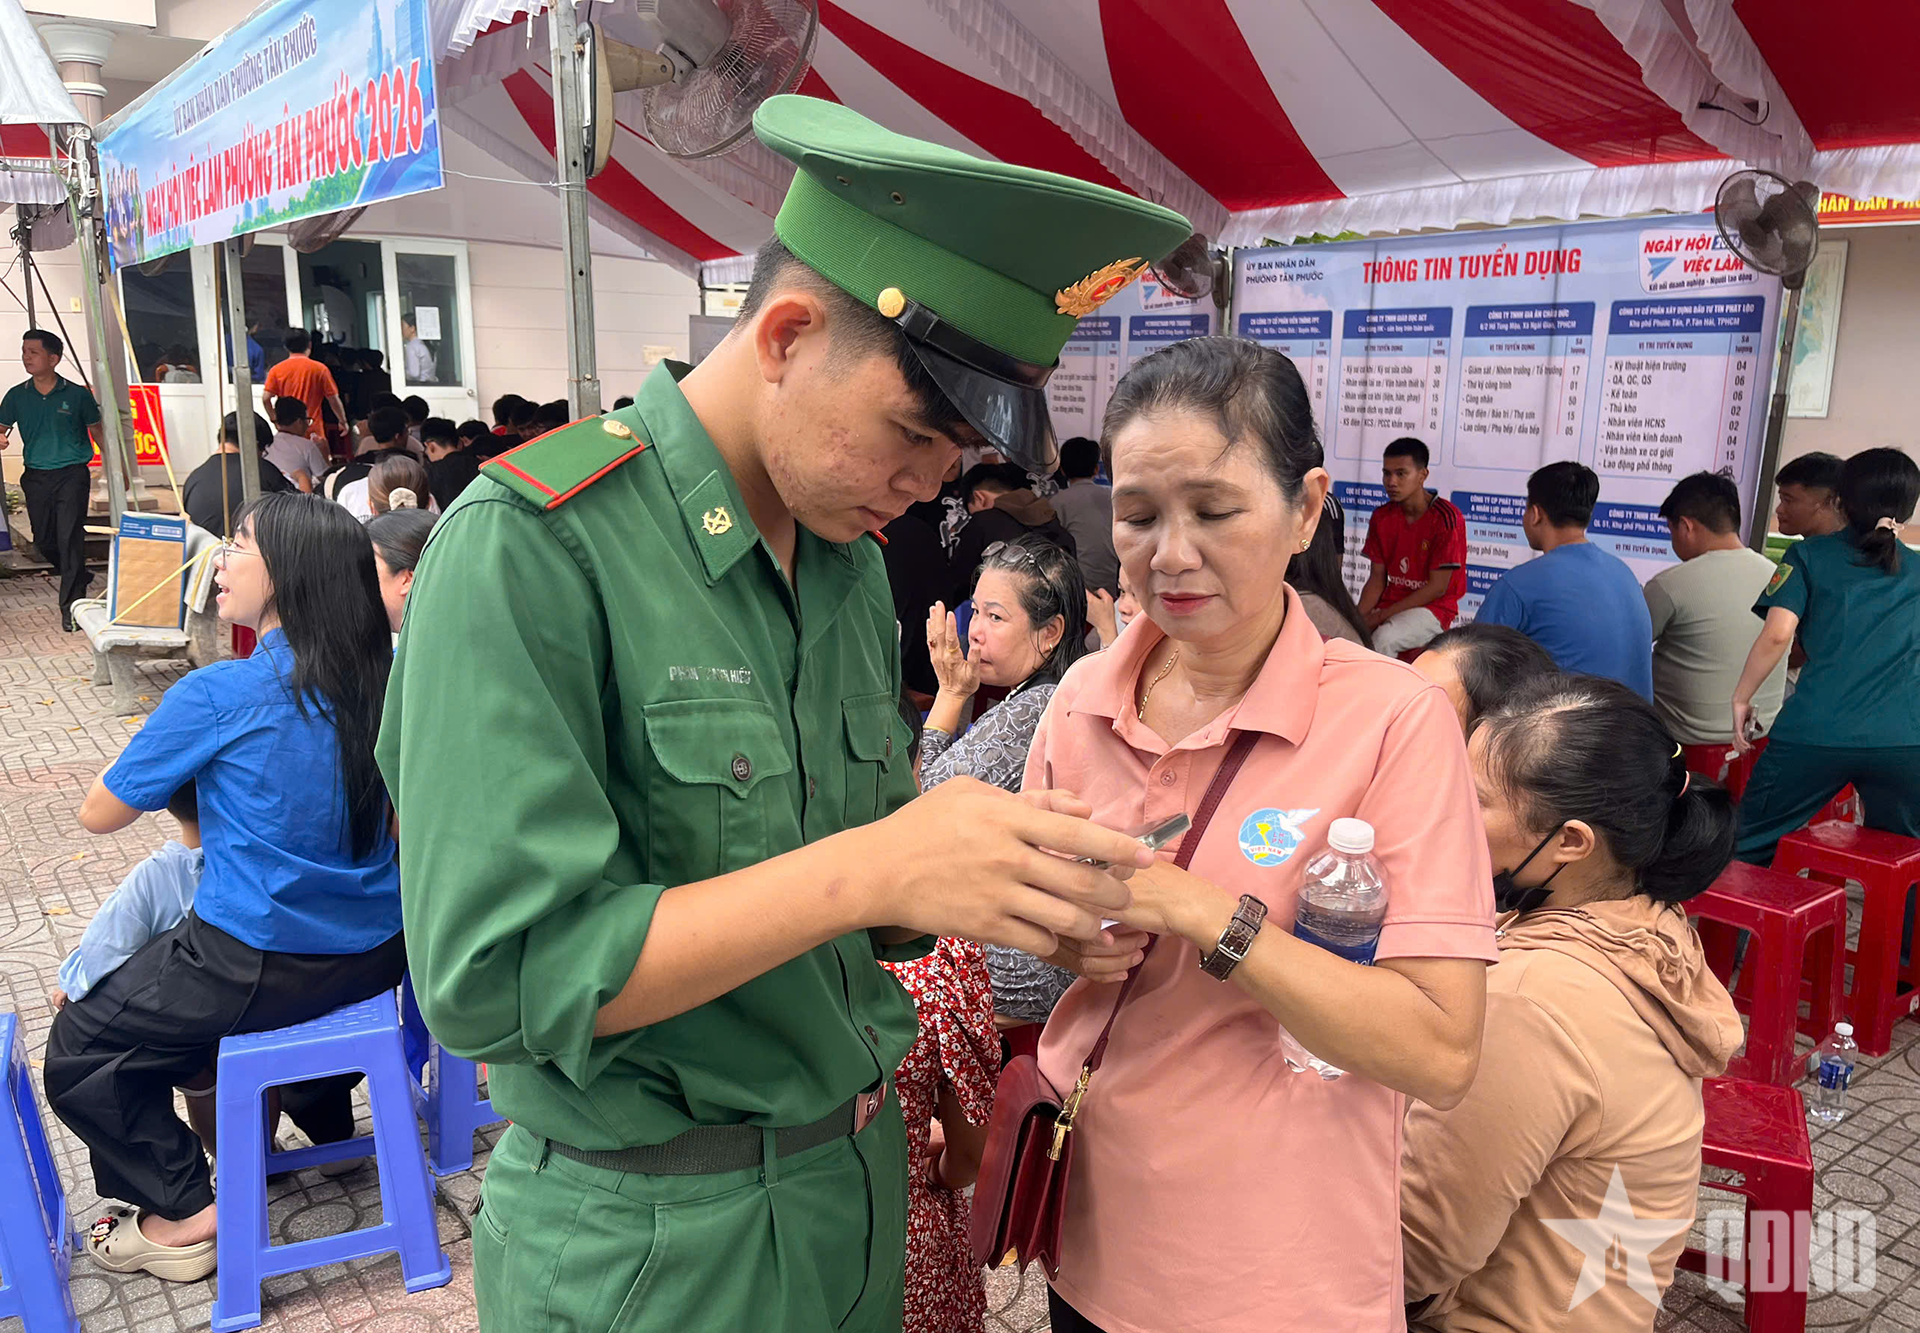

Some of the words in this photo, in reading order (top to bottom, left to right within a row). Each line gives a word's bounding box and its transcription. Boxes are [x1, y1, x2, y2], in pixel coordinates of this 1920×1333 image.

[215, 71, 231, 111] DÂN
[230, 52, 264, 101] PHƯỜNG
[264, 37, 283, 81] TÂN
[283, 14, 317, 70] PHƯỚC
[145, 171, 166, 238] NGÀY
[167, 161, 182, 242] HỘI
[182, 151, 202, 238] VIỆC
[202, 142, 223, 216] LÀM
[224, 119, 273, 209] PHƯỜNG
[275, 101, 302, 190] TÂN
[305, 69, 362, 181] PHƯỚC
[366, 60, 423, 163] 2026
[1644, 235, 1683, 253] NGÀY
[1685, 234, 1712, 255] HỘI
[1258, 262, 1273, 270] BAN
[1275, 259, 1297, 269] NHÂN
[1299, 257, 1316, 268] DÂN
[1363, 256, 1418, 284] THÔNG
[1424, 257, 1453, 281] TIN
[1459, 243, 1519, 279] TUYỂN
[1524, 248, 1582, 281] DỤNG
[1683, 256, 1711, 277] VIỆC
[1714, 254, 1744, 271] LÀM
[1246, 274, 1277, 284] PHƯỜNG
[1280, 272, 1294, 282] TÂN
[1296, 271, 1324, 281] PHƯỚC
[1635, 307, 1640, 316] TY
[1718, 317, 1740, 326] TPHCM
[1676, 341, 1693, 350] DỤNG
[1573, 366, 1580, 375] 17
[1614, 361, 1623, 371] Kỹ
[1625, 361, 1644, 371] thuật
[1645, 361, 1661, 371] hiện
[1663, 362, 1687, 373] trường
[1737, 361, 1747, 371] 04
[1613, 375, 1625, 386] QA,
[1627, 375, 1639, 386] QC,
[1641, 375, 1652, 385] QS
[1735, 376, 1745, 386] 06
[1570, 381, 1578, 391] 01
[1611, 388, 1621, 399] Kế
[1622, 390, 1638, 399] toán
[1733, 391, 1743, 401] 06
[1568, 396, 1577, 406] 50
[1610, 403, 1622, 413] Thủ
[1624, 404, 1637, 413] kho
[1731, 406, 1741, 416] 02
[1567, 412, 1575, 420] 15
[1430, 422, 1436, 430] 45
[1608, 418, 1626, 427] Nhân
[1628, 419, 1642, 428] viên
[1644, 419, 1666, 428] HCNS
[1729, 421, 1740, 431] 02
[1565, 427, 1573, 436] 05
[1606, 432, 1624, 441] Nhân
[1626, 432, 1641, 442] viên
[1643, 433, 1658, 442] kinh
[1660, 434, 1683, 444] doanh
[1727, 436, 1737, 446] 04
[1605, 445, 1618, 456] Vận
[1620, 445, 1637, 456] hành
[1640, 448, 1647, 456] xe
[1649, 448, 1658, 456] cơ
[1660, 448, 1674, 459] giới
[1726, 451, 1735, 461] 15
[1603, 460, 1616, 469] Lao
[1618, 460, 1635, 471] động
[1637, 459, 1650, 472] phổ
[1652, 462, 1672, 473] thông
[1626, 511, 1633, 519] TY
[1612, 521, 1622, 529] Khu
[1504, 532, 1517, 540] DỤNG
[1481, 545, 1491, 557] phổ
[1493, 548, 1509, 558] thông
